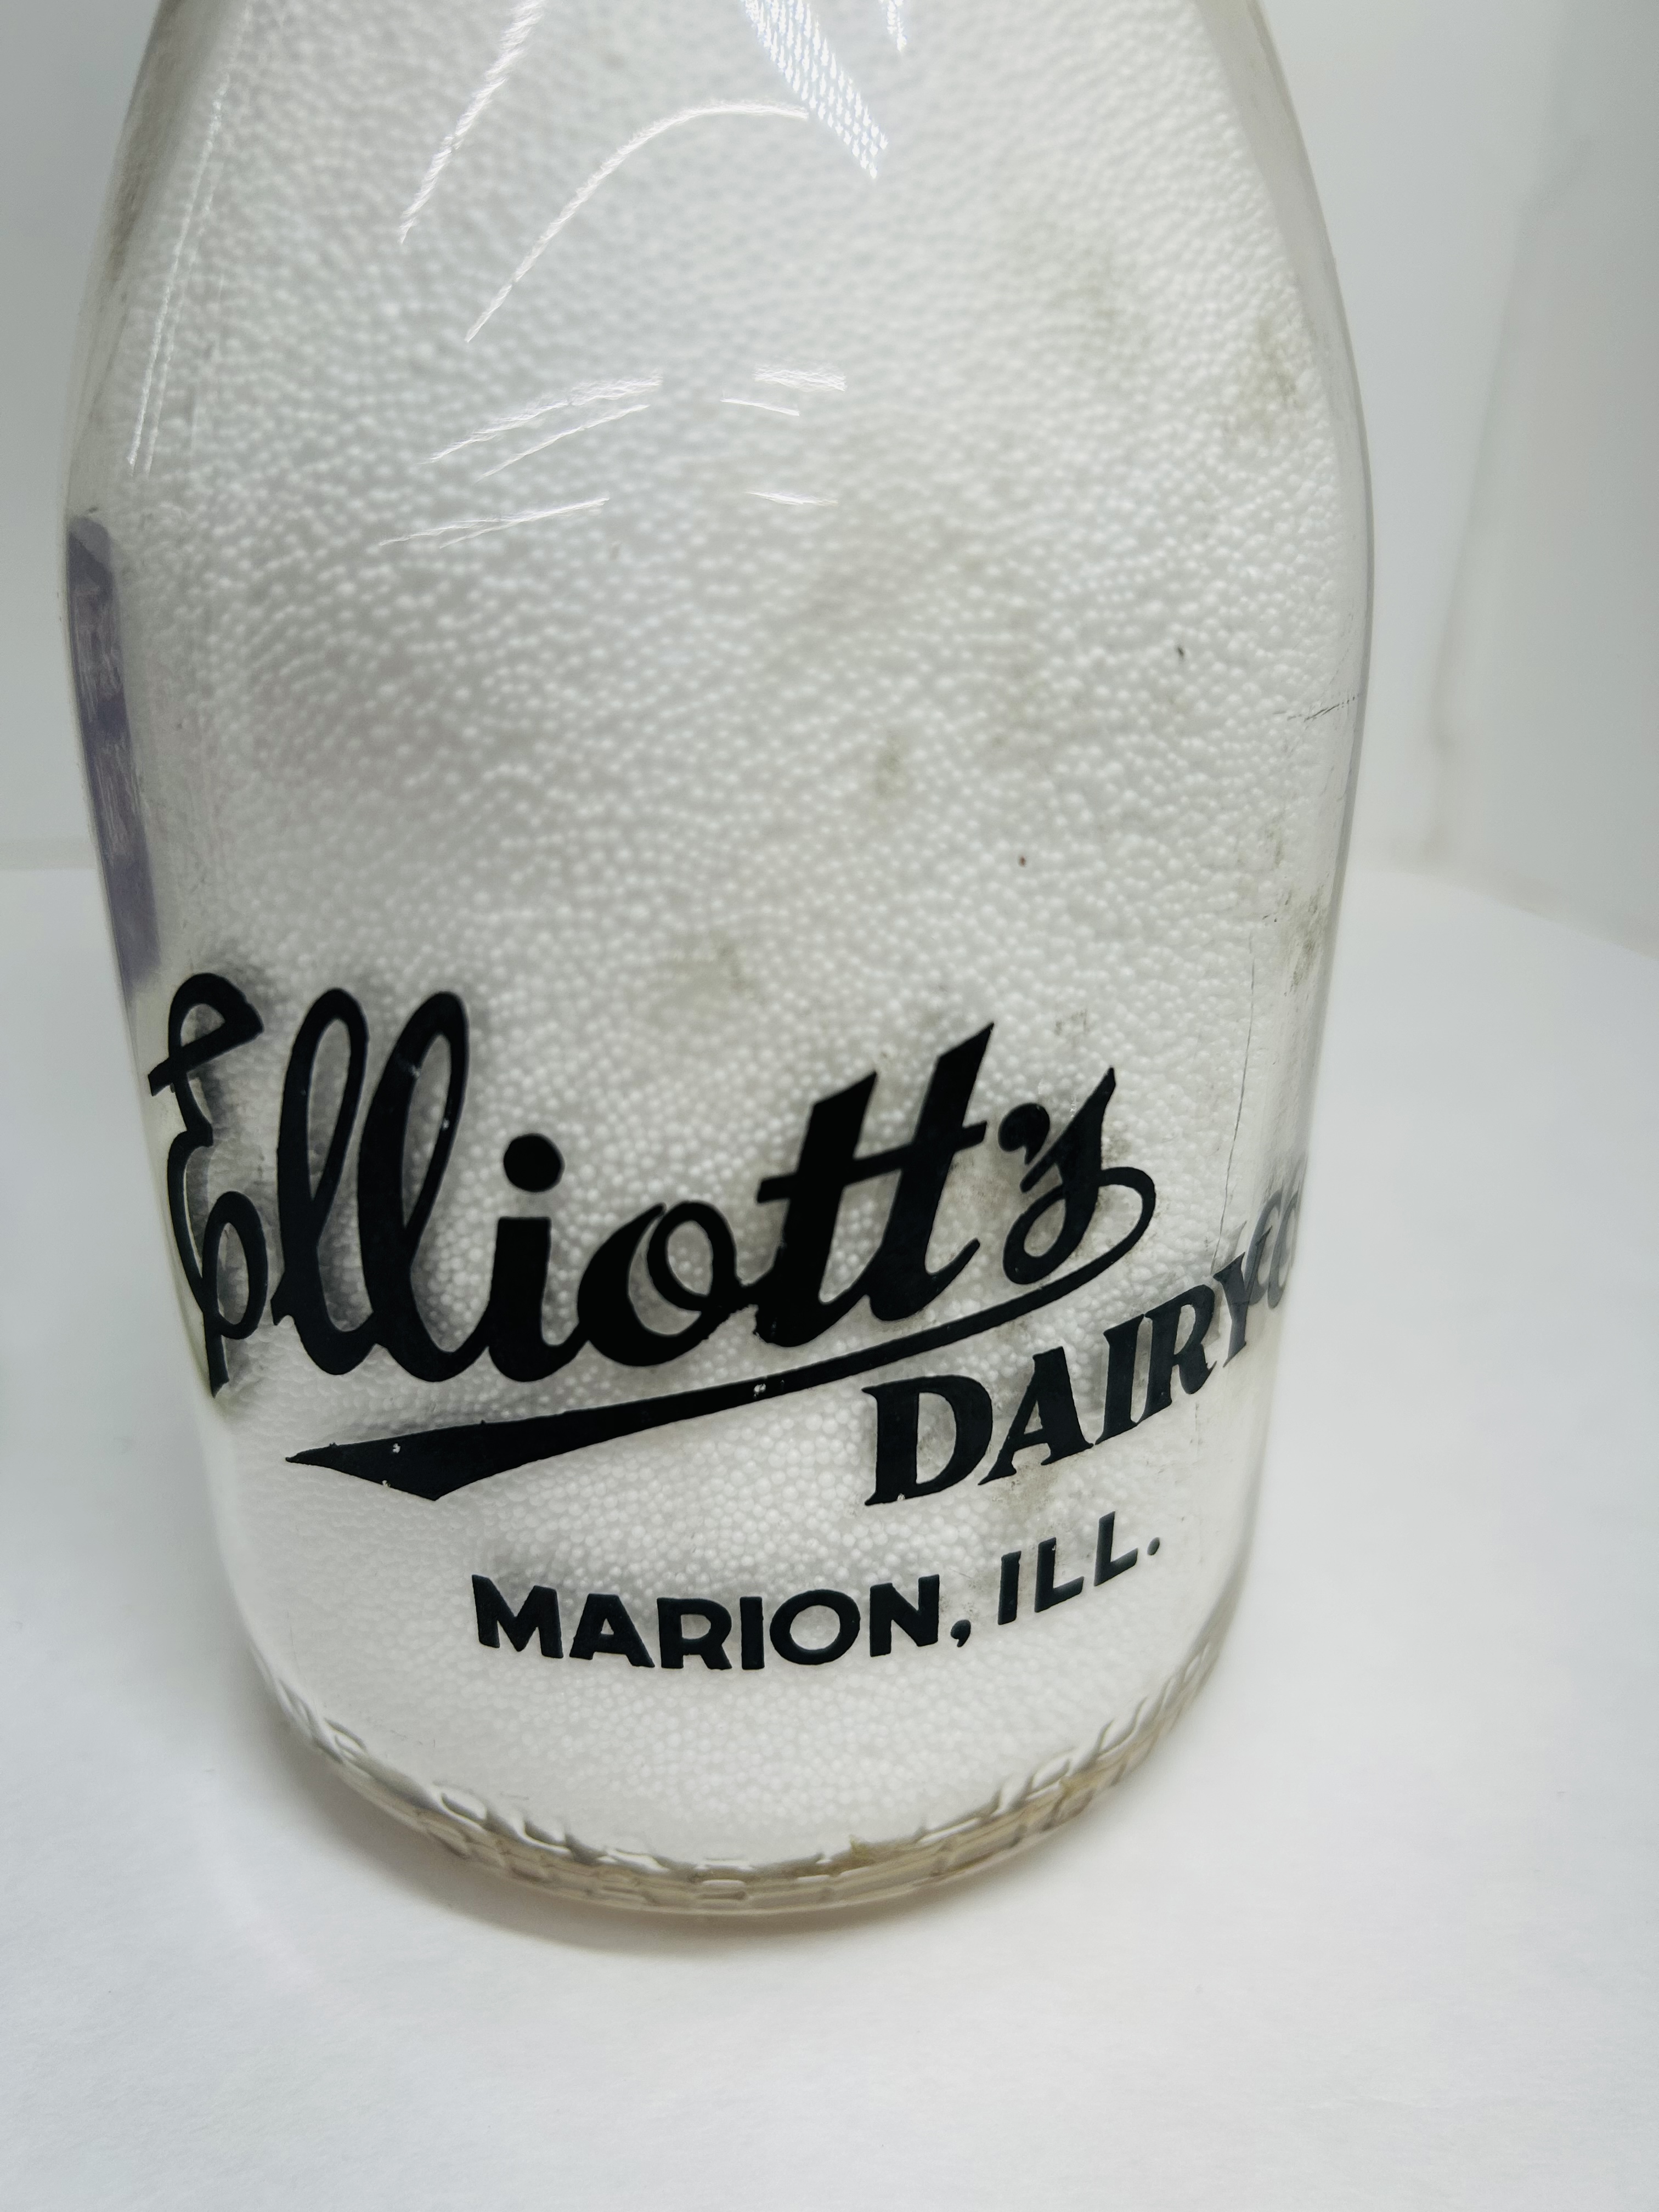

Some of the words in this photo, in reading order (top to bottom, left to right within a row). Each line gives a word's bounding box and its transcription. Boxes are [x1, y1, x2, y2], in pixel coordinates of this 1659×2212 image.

[148, 972, 1156, 1398] Elliott's
[861, 1226, 1272, 1506] DAIRY
[471, 1573, 972, 1670] MARION,
[997, 1510, 1160, 1626] ILL.
